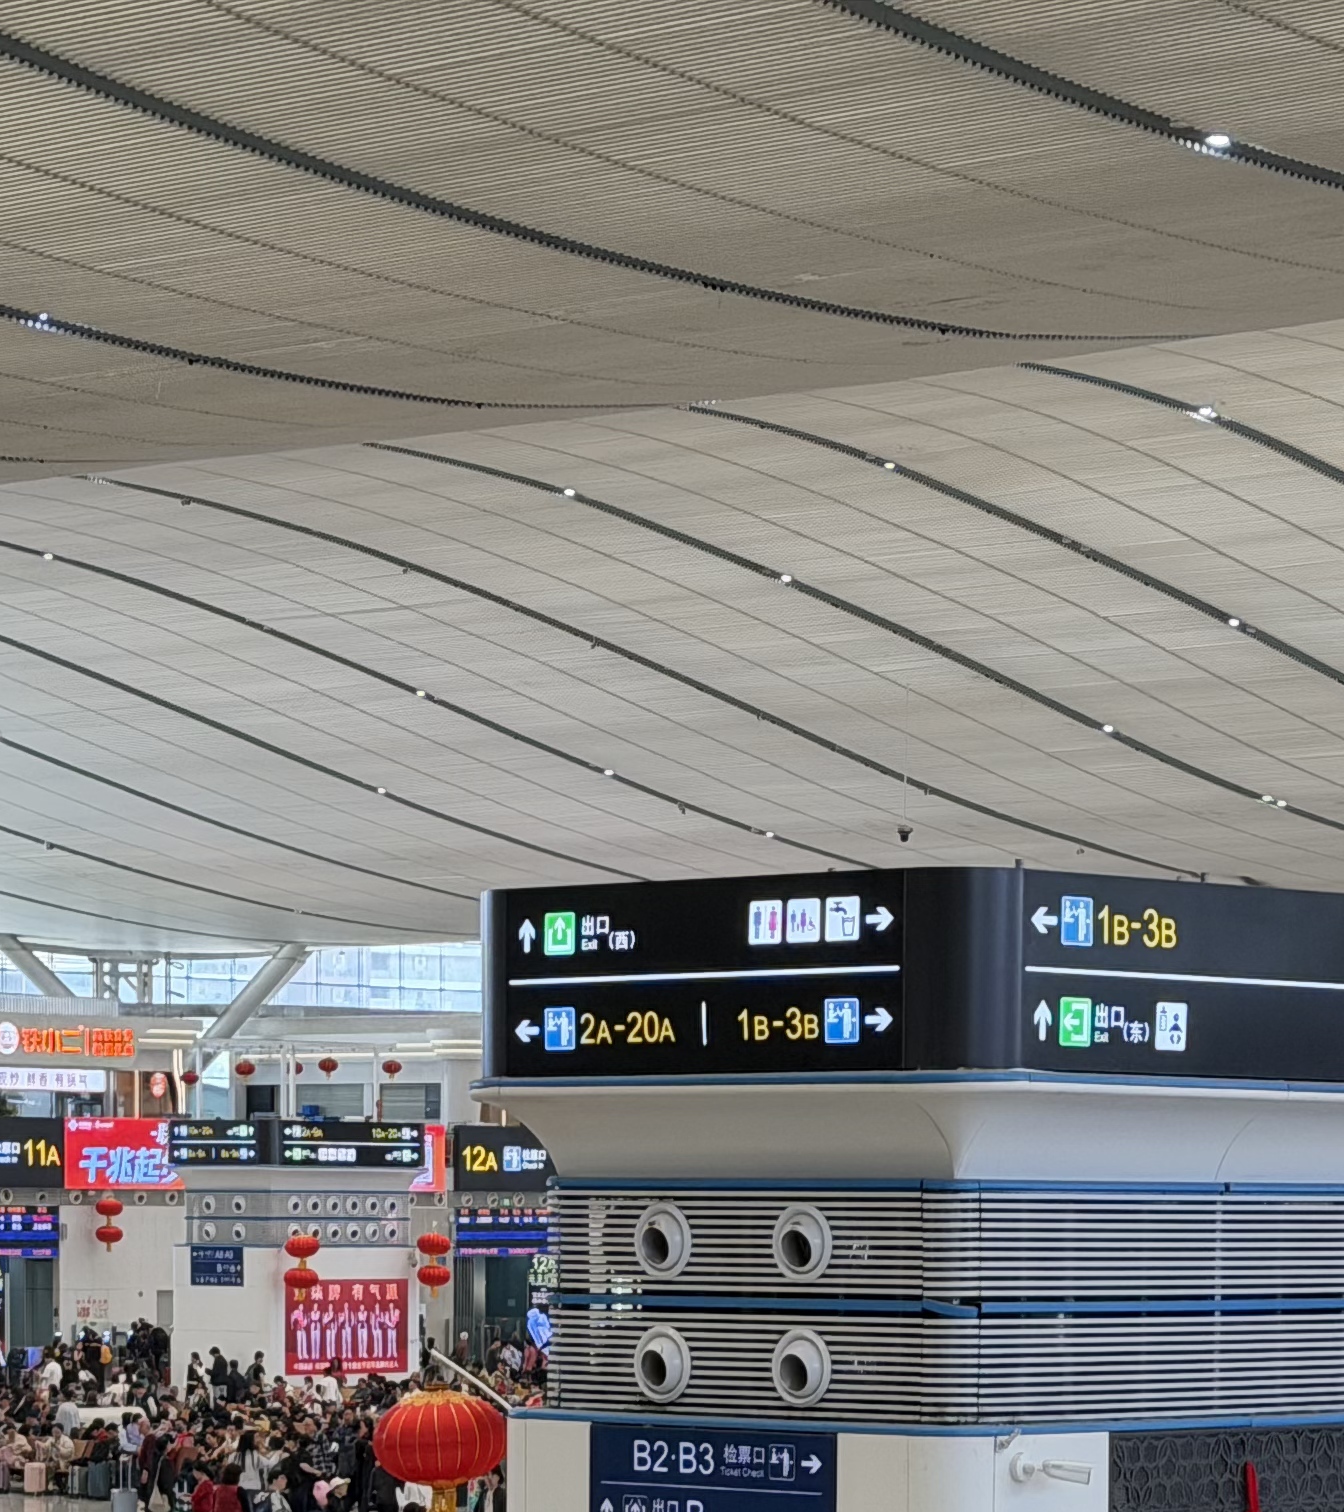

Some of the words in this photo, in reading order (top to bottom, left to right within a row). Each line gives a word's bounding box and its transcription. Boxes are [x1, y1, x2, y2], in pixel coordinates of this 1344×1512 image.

[581, 915, 610, 934] 出口
[1097, 905, 1177, 948] 1B-3B
[580, 1011, 675, 1045] 2A-20A
[737, 1007, 819, 1040] 1B-3B
[1094, 1004, 1124, 1028] 出口
[22, 1028, 82, 1053] 铁小二
[24, 1138, 61, 1167] 11A
[461, 1145, 498, 1172] 12A
[722, 1443, 765, 1465] 检票口
[720, 1466, 742, 1477] Ticket
[742, 1467, 764, 1478] Check
